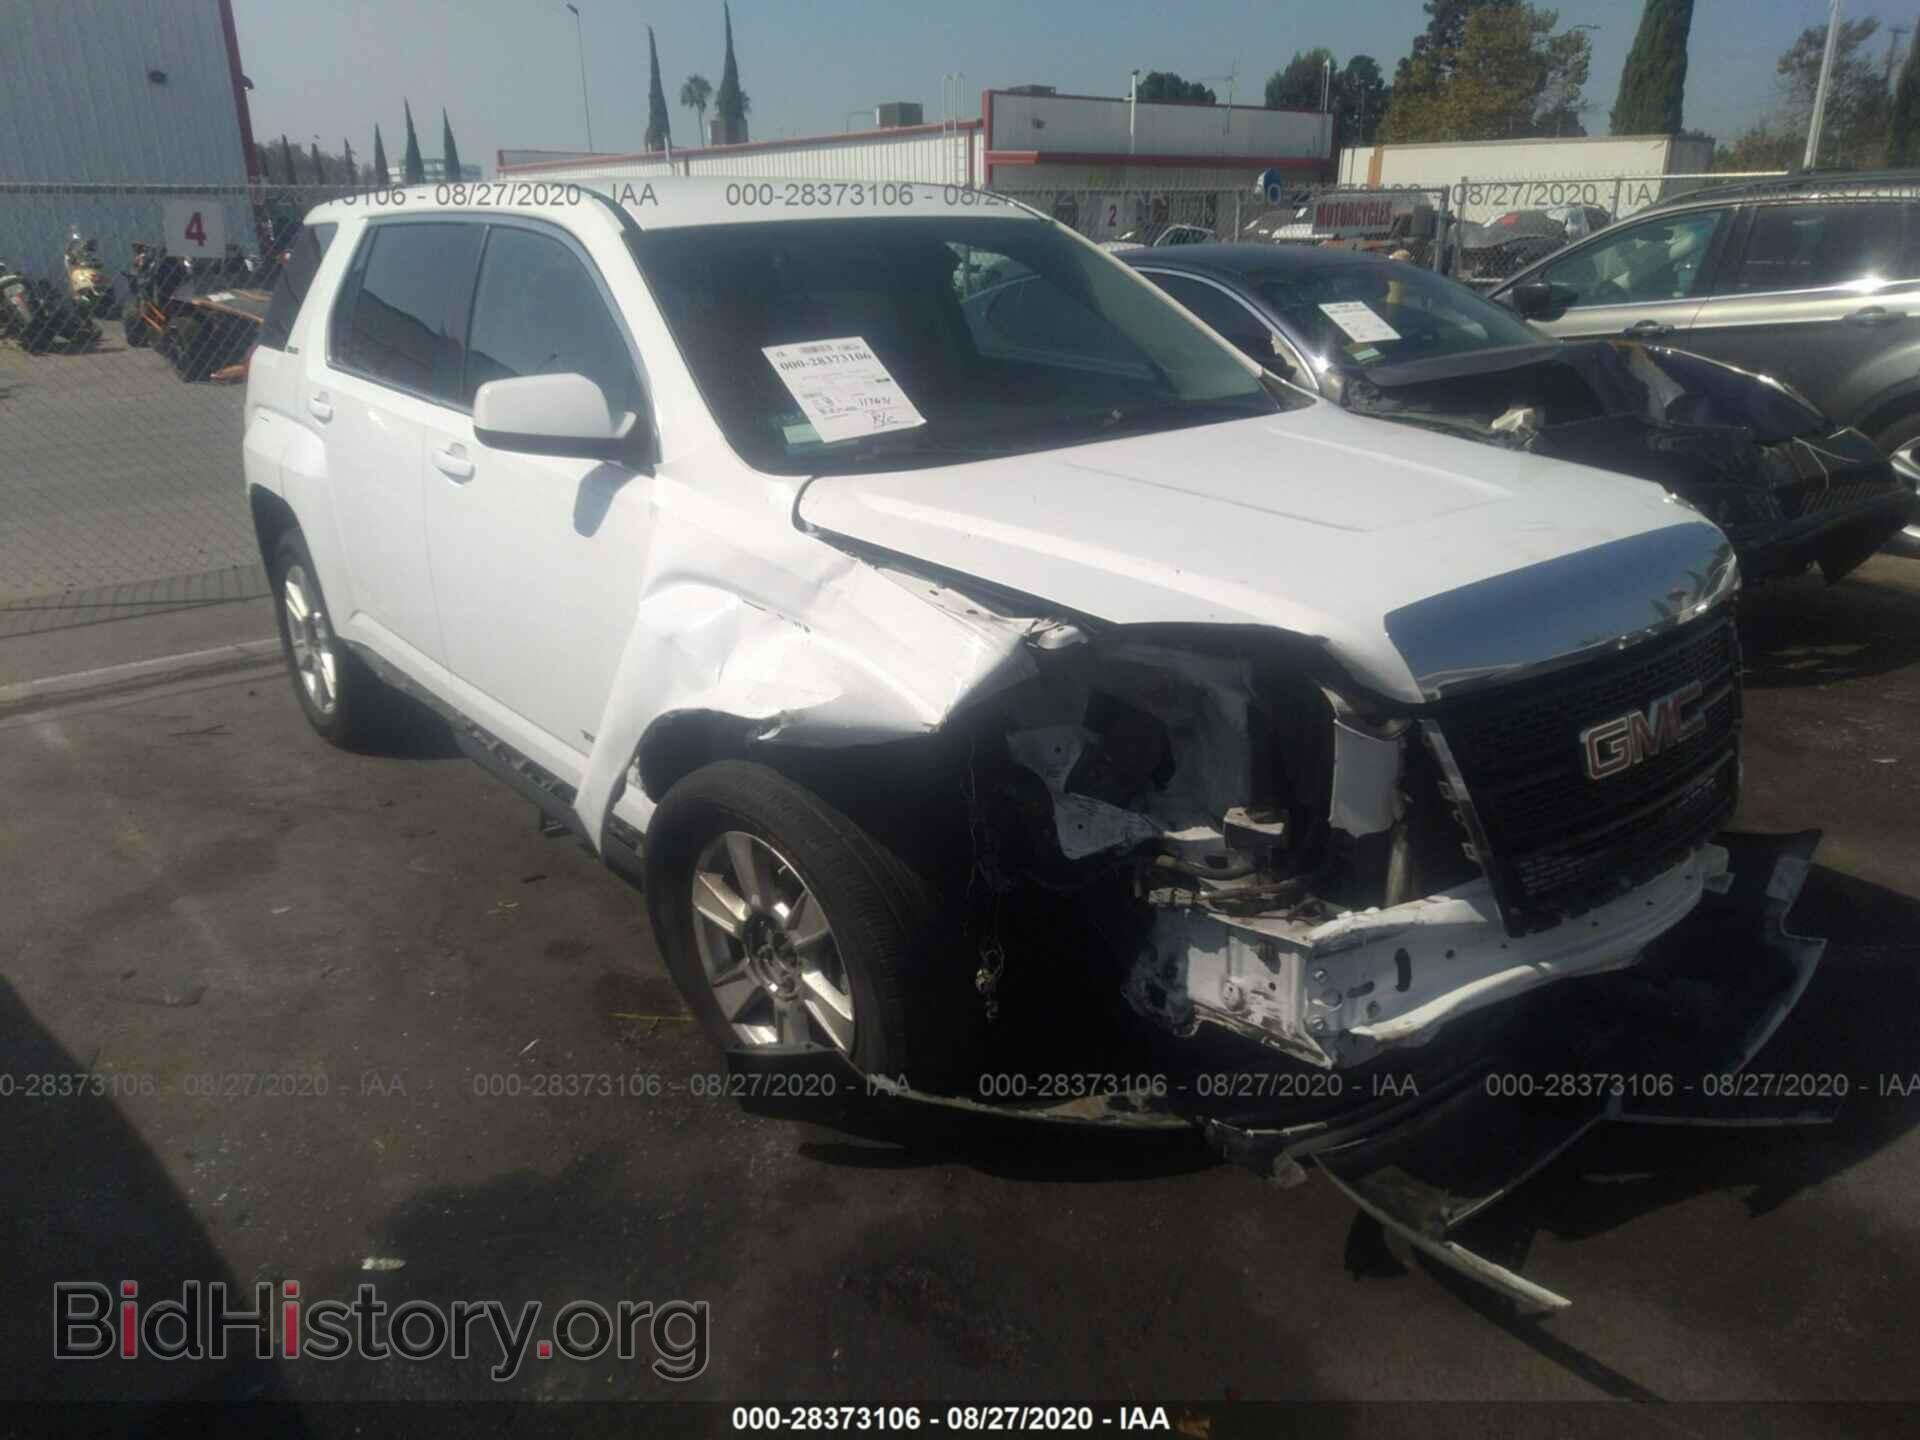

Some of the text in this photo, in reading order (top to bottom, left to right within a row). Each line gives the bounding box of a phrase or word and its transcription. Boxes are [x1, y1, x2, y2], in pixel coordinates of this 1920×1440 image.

[1107, 204, 1118, 227] 2
[1317, 200, 1393, 226] MOTORCYCLES
[184, 211, 207, 247] 4
[779, 351, 873, 370] 000-28373106
[1580, 679, 1707, 780] GMC
